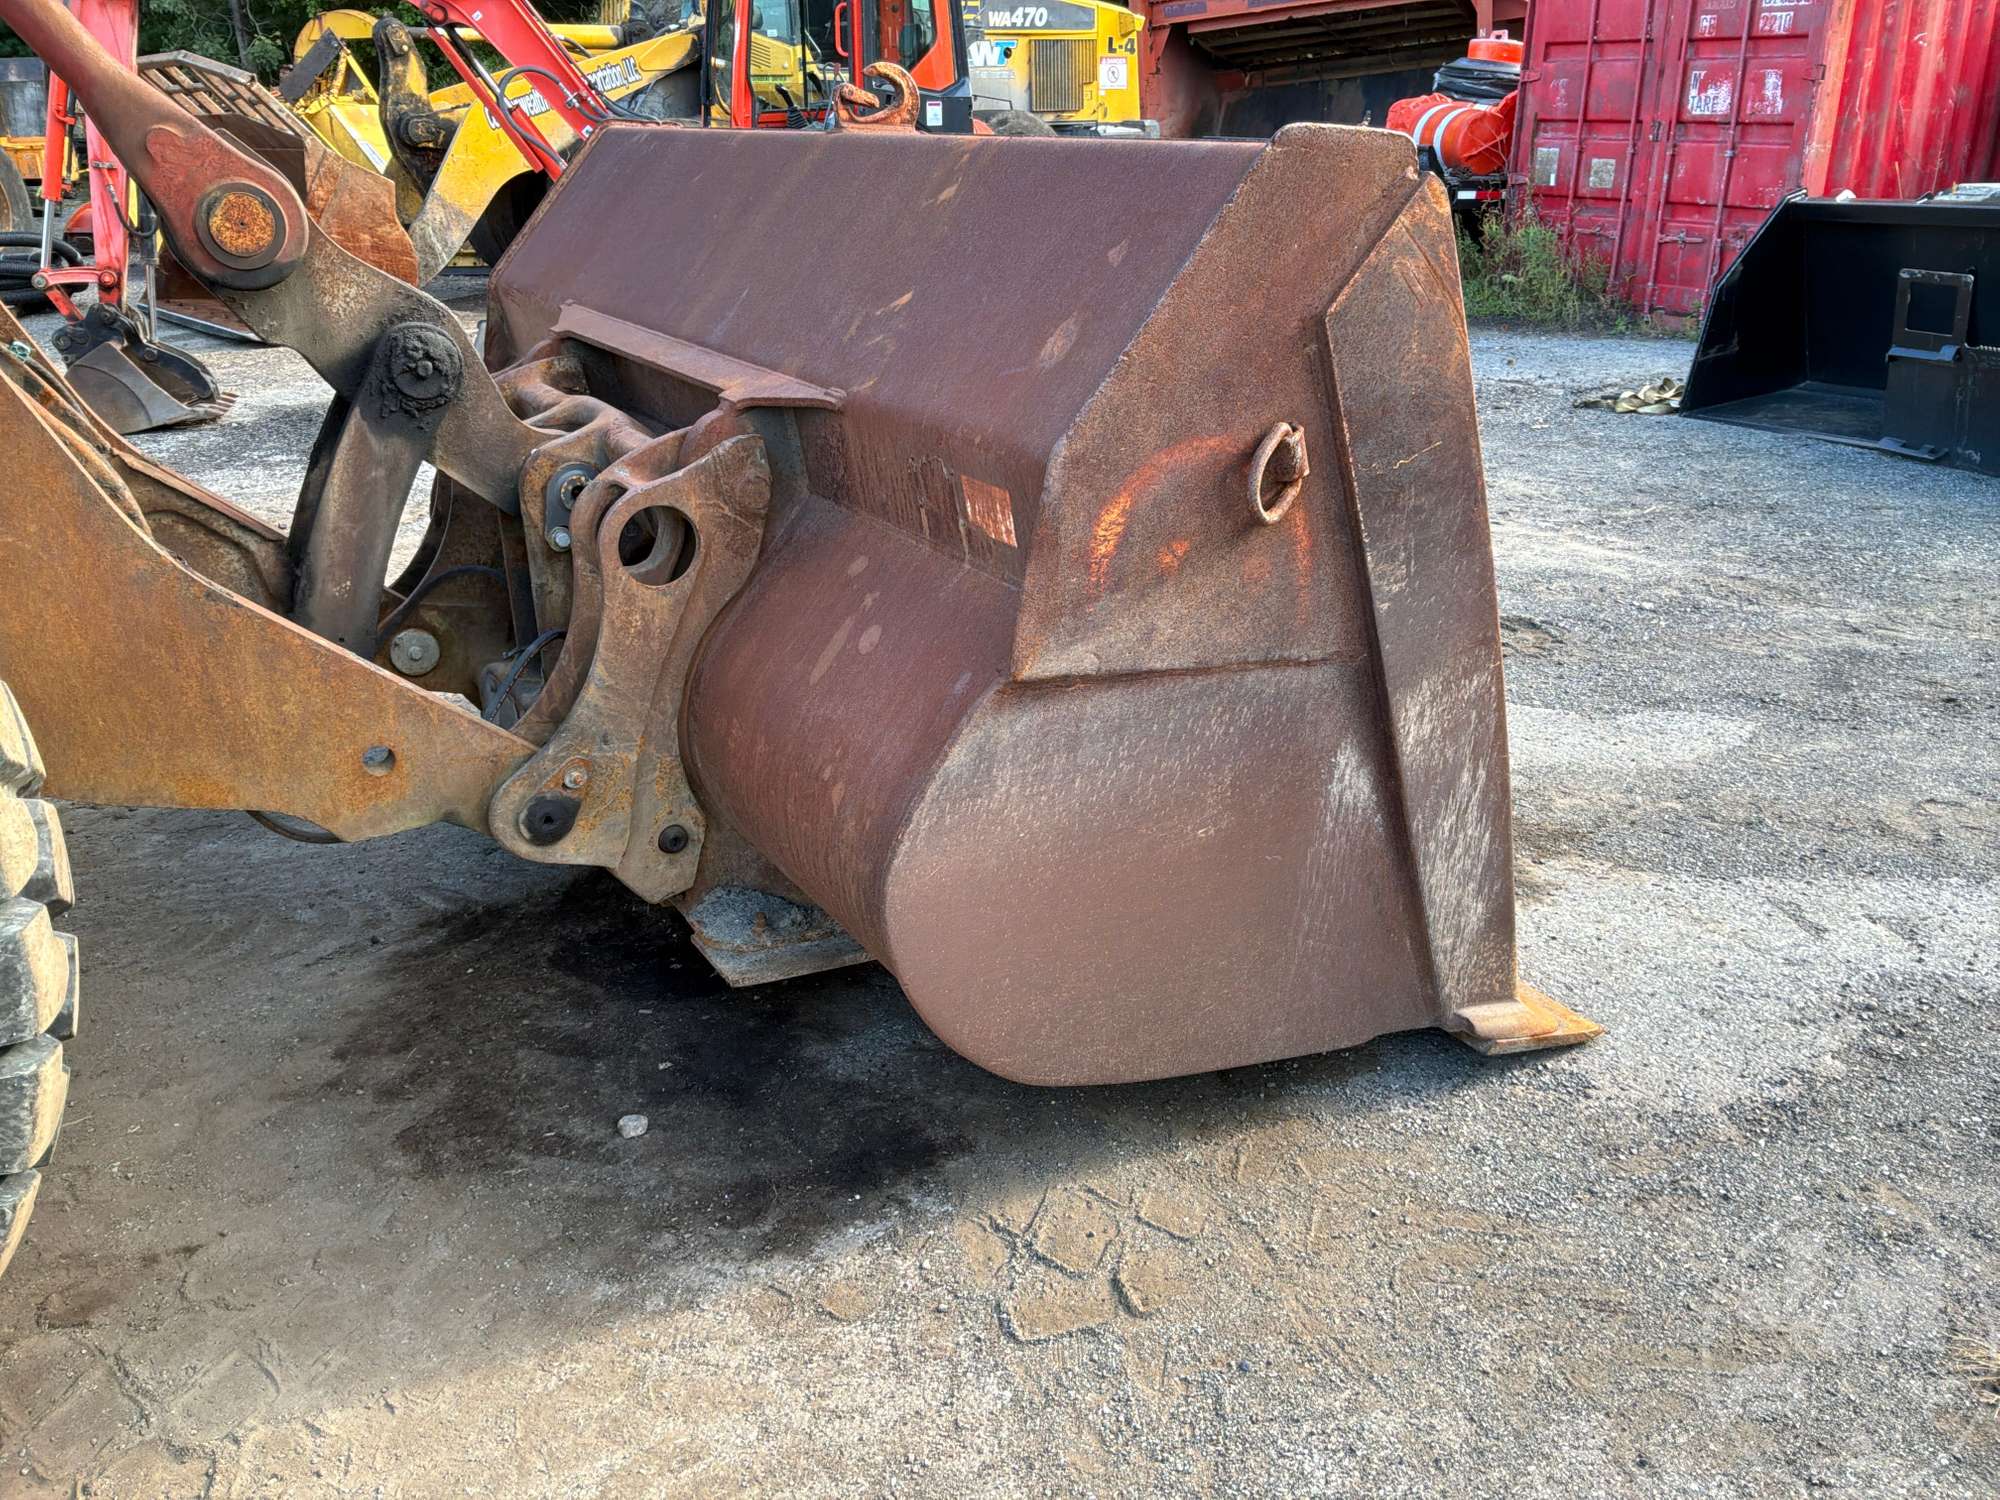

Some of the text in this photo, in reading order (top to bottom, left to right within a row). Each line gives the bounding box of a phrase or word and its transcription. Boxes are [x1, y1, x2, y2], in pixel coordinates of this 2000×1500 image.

[988, 7, 1048, 27] WA470
[1107, 36, 1137, 54] L-4
[1690, 95, 1719, 113] TARE
